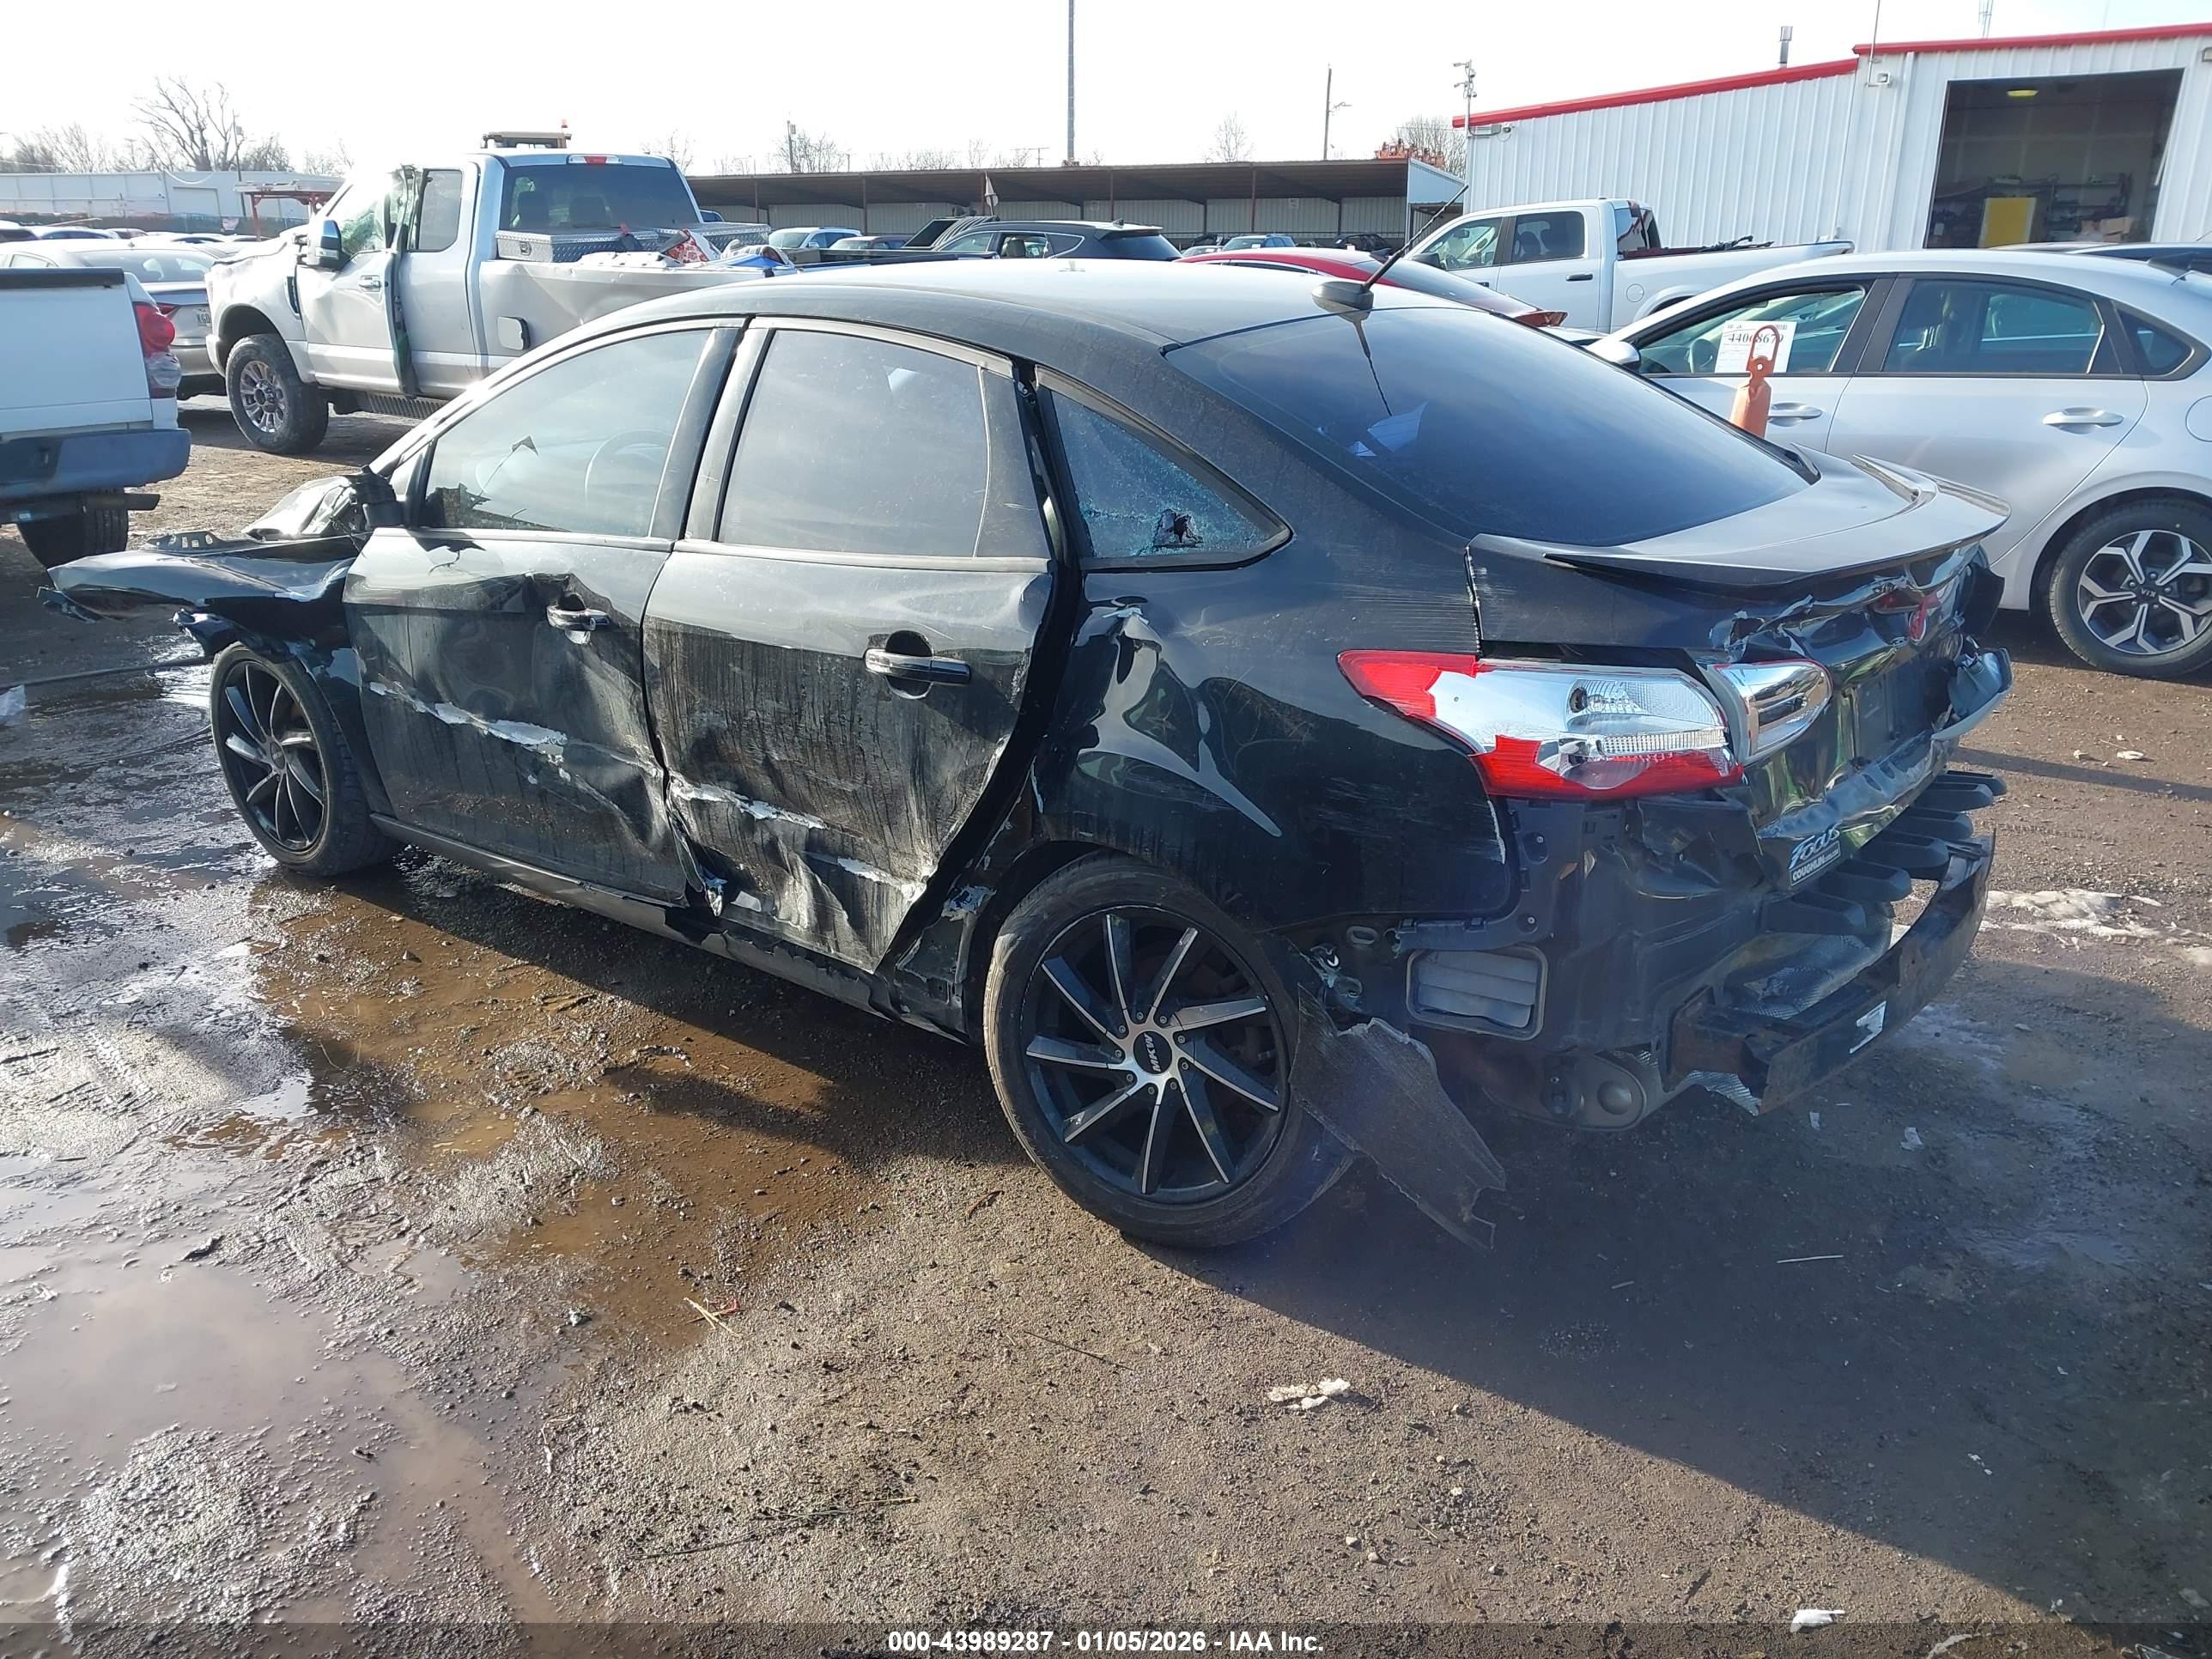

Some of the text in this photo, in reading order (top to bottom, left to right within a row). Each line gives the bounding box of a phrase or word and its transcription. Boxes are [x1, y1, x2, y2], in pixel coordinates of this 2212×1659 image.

[2141, 587, 2156, 598] KIA
[1789, 820, 1842, 870] Focus
[1143, 1032, 1162, 1073] MKW
